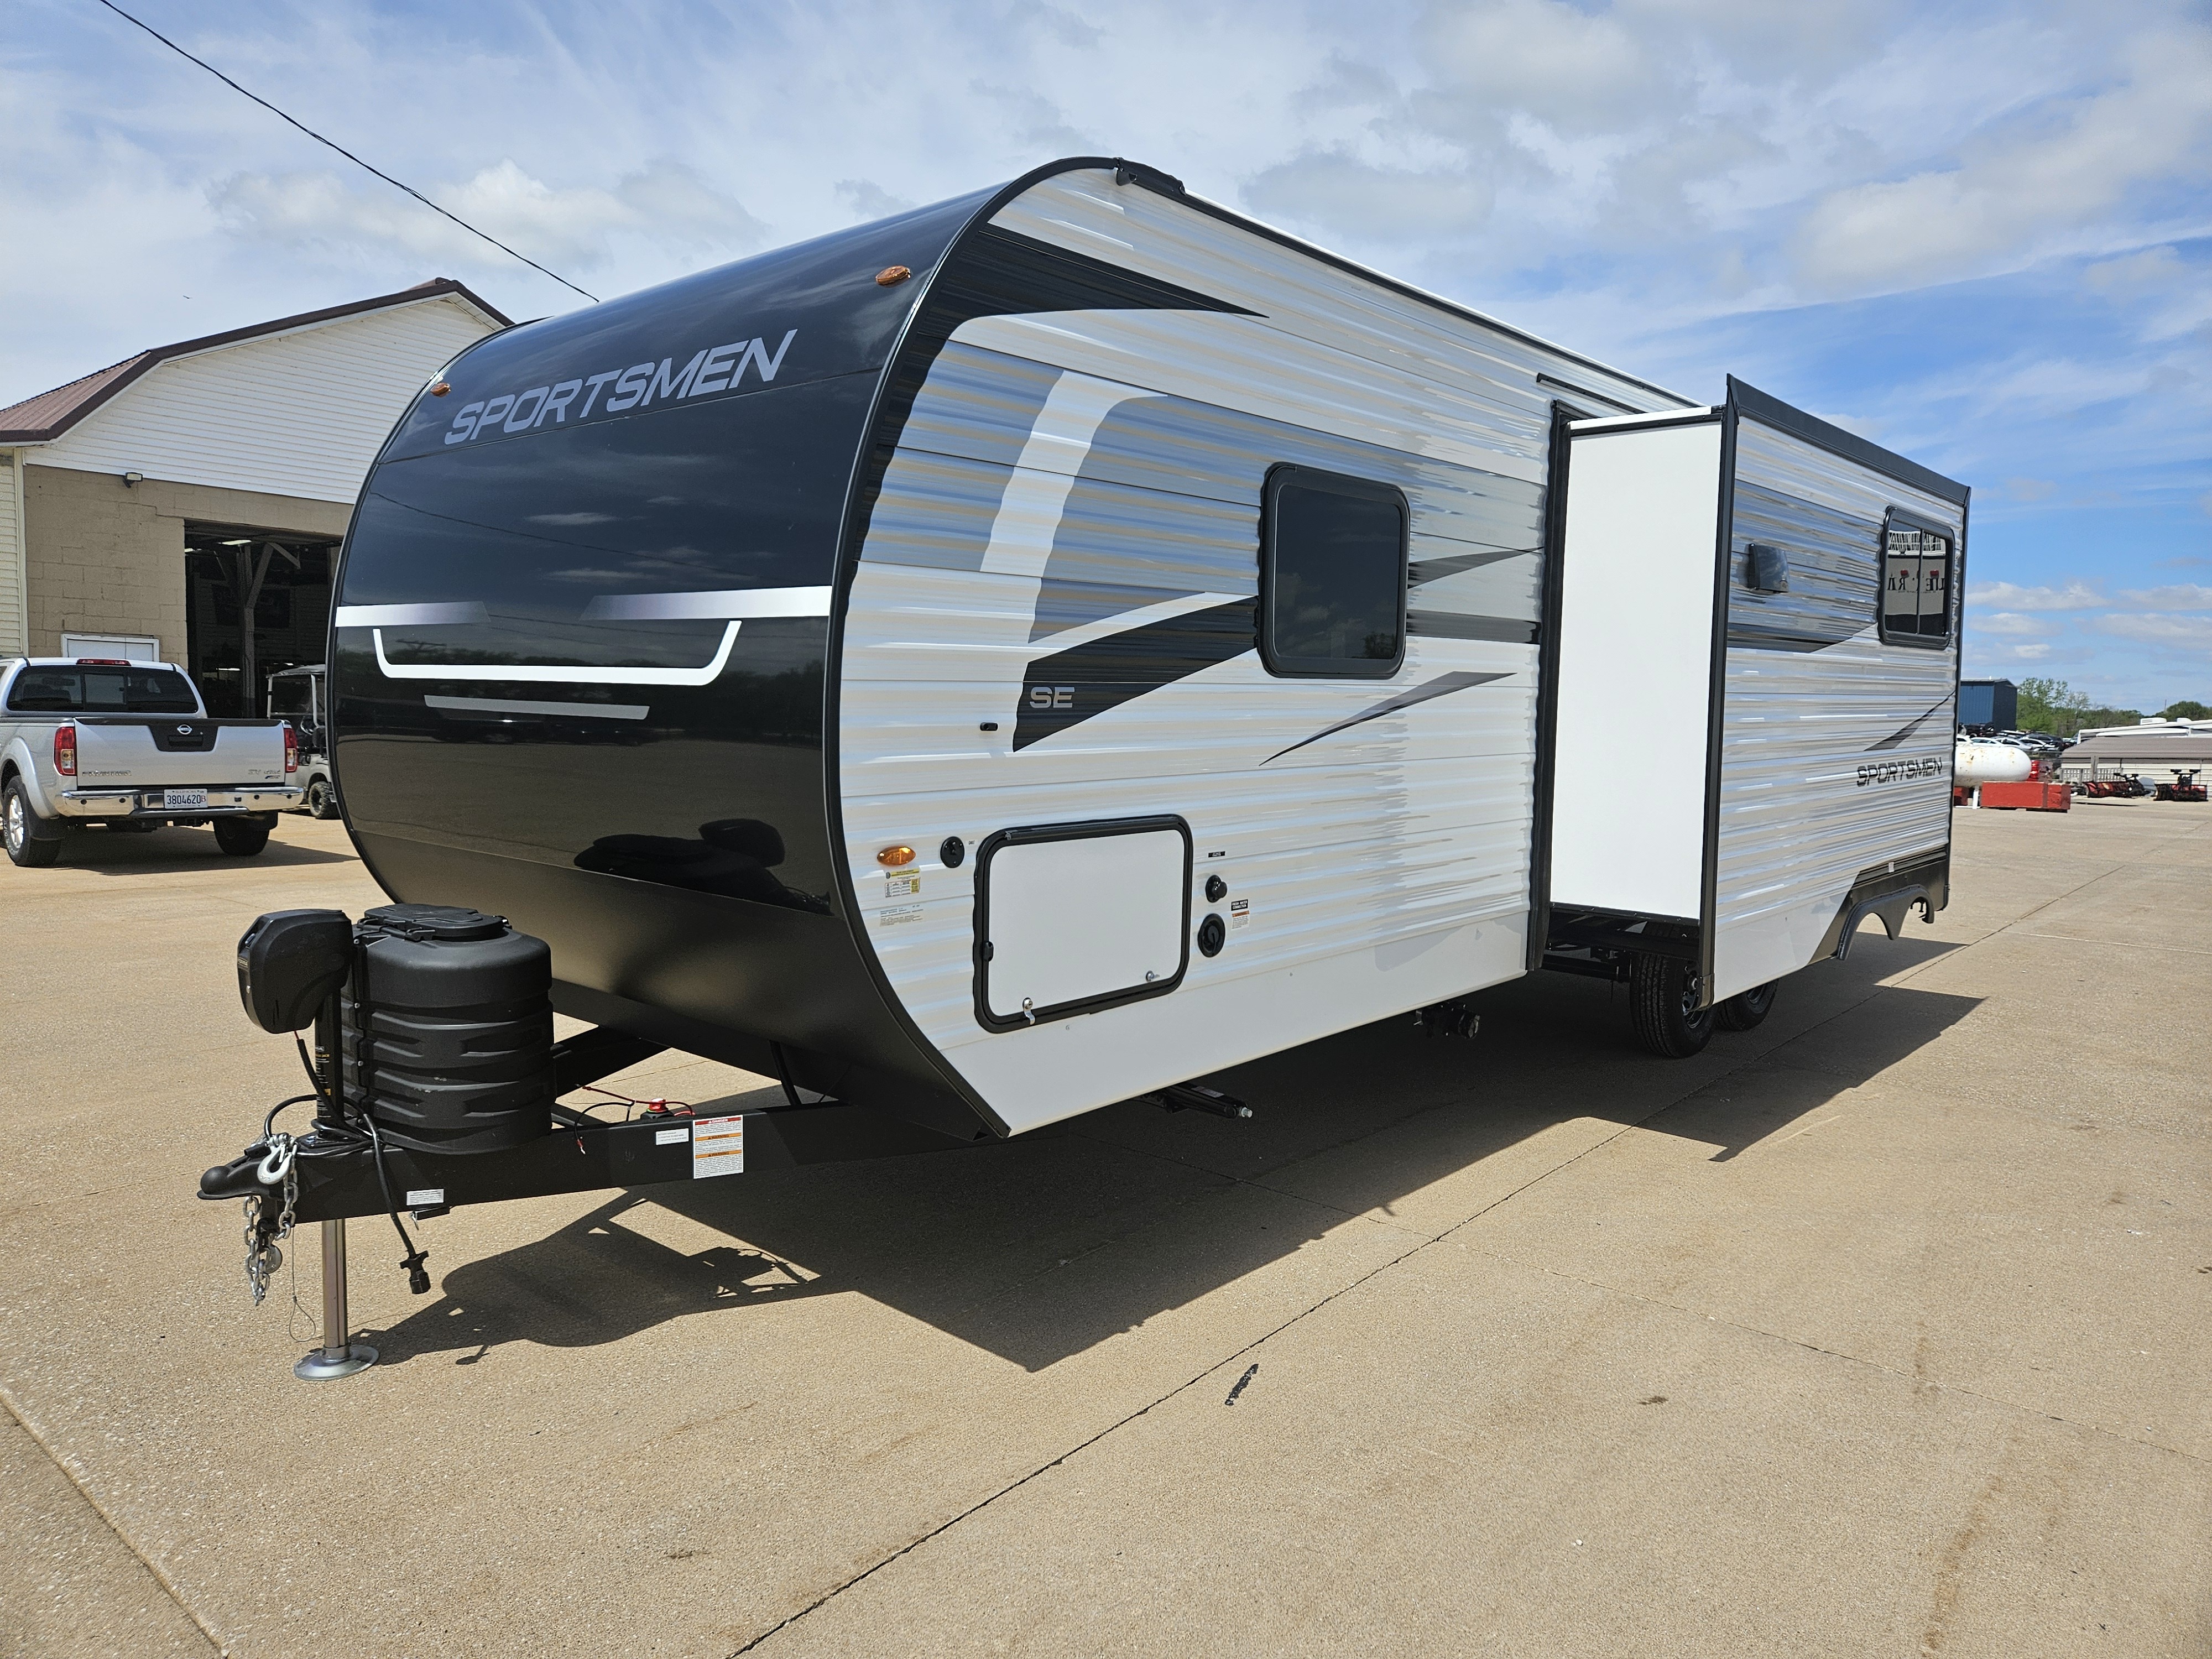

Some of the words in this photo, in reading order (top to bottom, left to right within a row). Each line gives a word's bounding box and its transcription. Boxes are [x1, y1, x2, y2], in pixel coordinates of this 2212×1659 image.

[444, 328, 798, 445] SPORTSMEN
[1030, 686, 1075, 708] SE
[1857, 757, 1943, 787] SPORTSMEN
